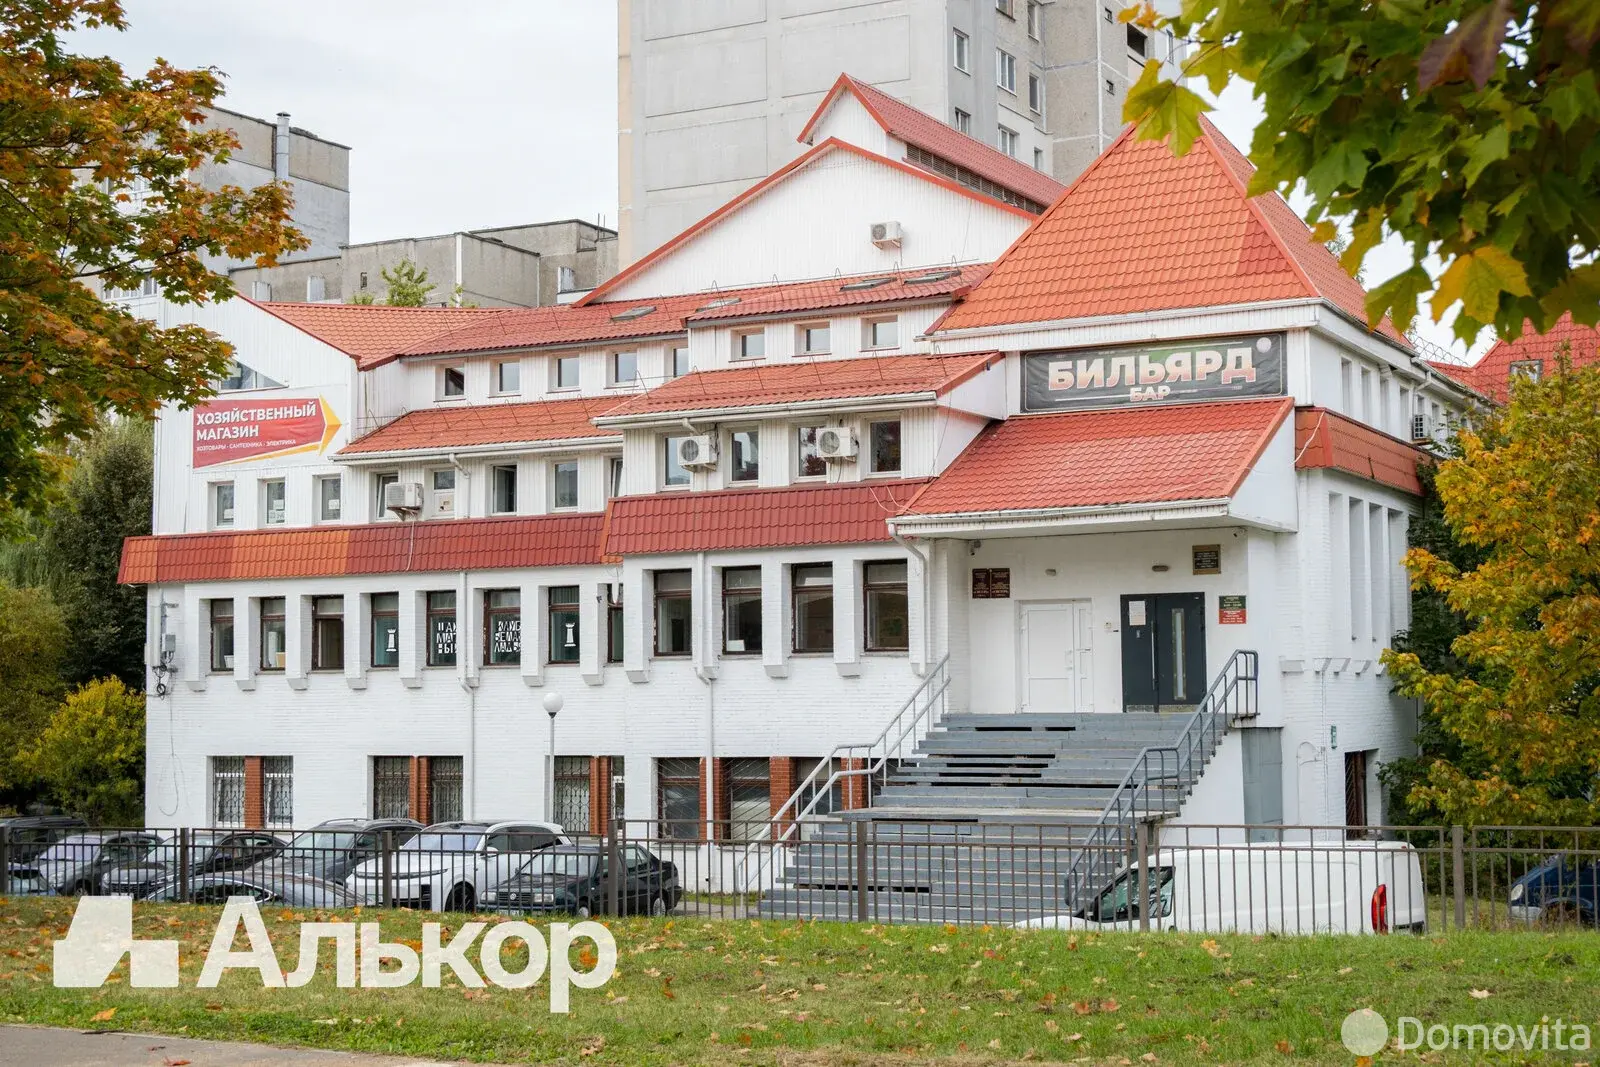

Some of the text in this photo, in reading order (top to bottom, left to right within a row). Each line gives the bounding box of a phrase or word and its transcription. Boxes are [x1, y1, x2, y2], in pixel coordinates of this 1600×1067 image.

[1048, 347, 1256, 391] БИЛЬЯРД
[1130, 385, 1170, 402] БАР
[196, 401, 316, 426] ХОЗЯЙСТВЕННЫЙ
[196, 425, 259, 441] МАГАЗИН
[196, 439, 297, 452] ХОЗТОВАРЫ САНТЕХНИКА ЭЛЕКТРИКА
